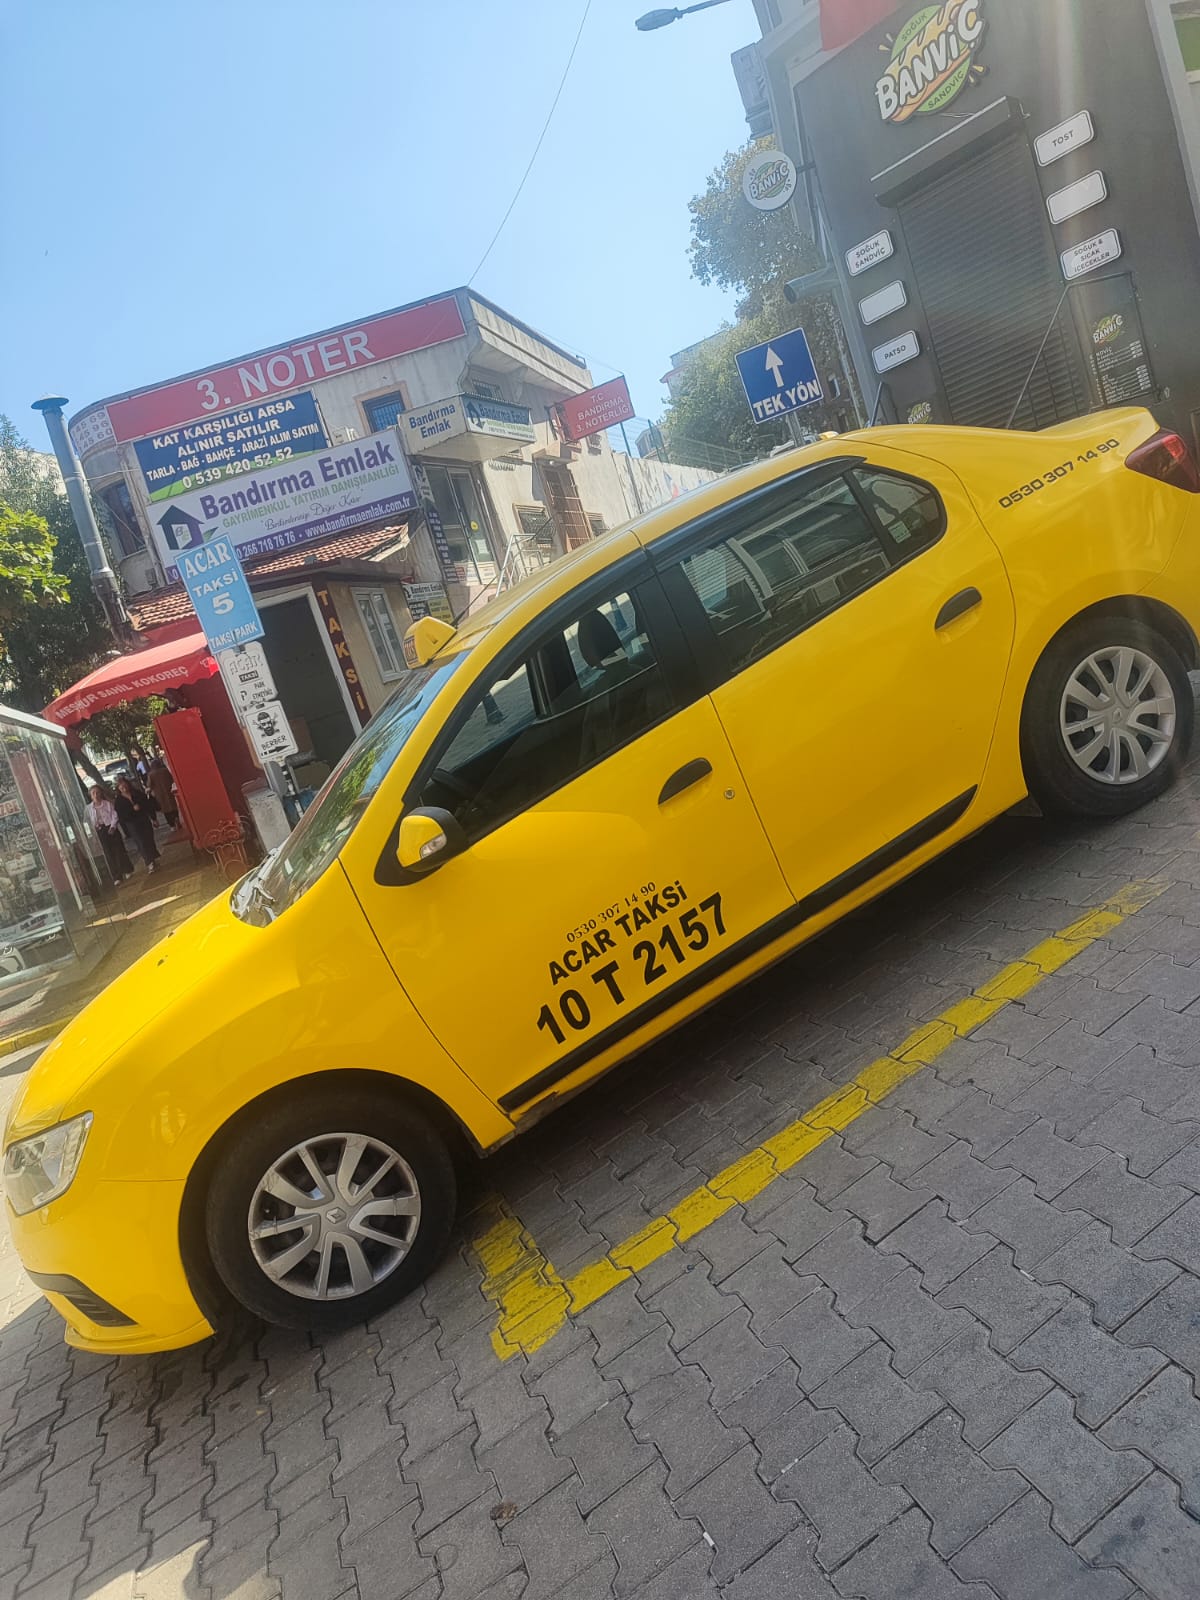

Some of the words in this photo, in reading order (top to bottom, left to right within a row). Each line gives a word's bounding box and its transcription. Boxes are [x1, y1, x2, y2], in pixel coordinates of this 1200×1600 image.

[902, 12, 928, 41] SOĞUK
[928, 70, 964, 109] SANDVİÇ
[1052, 130, 1074, 147] TOST
[856, 240, 880, 258] SOĞUK
[884, 345, 907, 359] PATSO
[197, 379, 231, 410] 3.
[238, 331, 376, 397] NOTER
[753, 396, 786, 418] TEK
[787, 379, 821, 405] YÖN
[153, 433, 180, 449] KAT
[184, 412, 254, 440] KARŞILIĞI
[258, 400, 295, 419] ARSA
[408, 402, 456, 428] Bandırma
[420, 418, 451, 438] Emlak
[147, 465, 176, 481] TARLA
[181, 454, 200, 471] BAĞ
[206, 447, 236, 464] BAHÇE
[242, 437, 269, 453] ARAZİ
[270, 432, 291, 446] ALIM
[292, 423, 319, 439] SATIM
[178, 437, 224, 458] ALINIR
[228, 419, 281, 443] SATILIR
[182, 476, 192, 489] 0
[195, 467, 222, 485] 539
[225, 459, 250, 475] 420
[255, 452, 272, 467] 52
[276, 446, 294, 461] 52
[200, 469, 315, 520] Bandırma
[319, 441, 395, 482] Emlak
[998, 478, 1044, 509] 0530
[1043, 461, 1075, 483] 307
[1077, 450, 1098, 463] 14
[1096, 438, 1120, 453] 90
[292, 486, 330, 506] YATIRIM
[245, 545, 257, 557] 266
[258, 540, 273, 553] 718
[274, 536, 284, 546] 76
[285, 531, 296, 543] 76
[184, 543, 231, 578] ACAR
[192, 568, 238, 597] TAKSİ
[212, 592, 234, 615] 5
[234, 623, 257, 641] PARK
[133, 666, 189, 689] KOKOREÇ
[261, 735, 287, 751] BERBER
[566, 918, 597, 943] 0530
[598, 903, 621, 923] 307
[624, 893, 639, 908] 14
[640, 881, 656, 897] 90
[548, 928, 616, 986] ACAR
[615, 880, 688, 937] TAKSİ
[537, 989, 591, 1044] 10
[592, 960, 625, 1005] T
[632, 892, 727, 985] 2157
